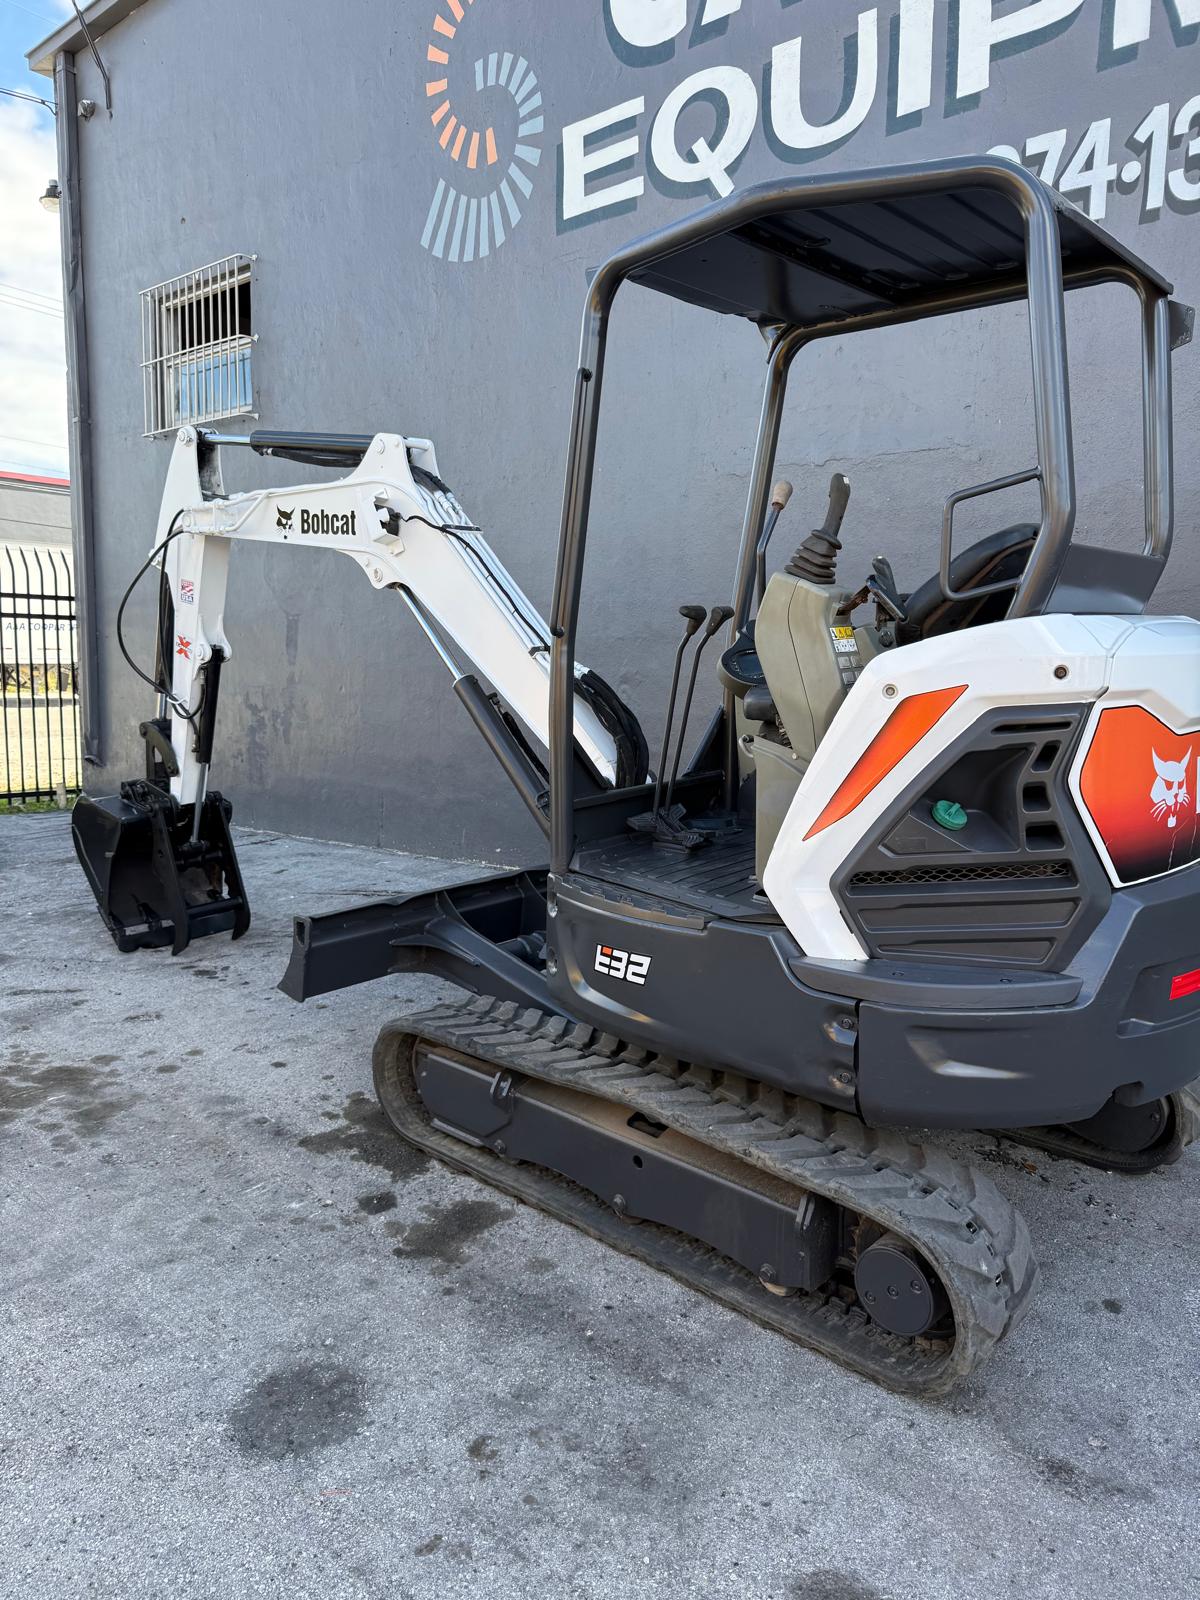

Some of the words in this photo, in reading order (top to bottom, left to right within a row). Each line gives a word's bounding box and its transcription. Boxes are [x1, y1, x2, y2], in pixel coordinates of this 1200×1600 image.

[562, 0, 1200, 221] EQUIP
[300, 508, 357, 536] Bobcat
[594, 944, 652, 985] E32
